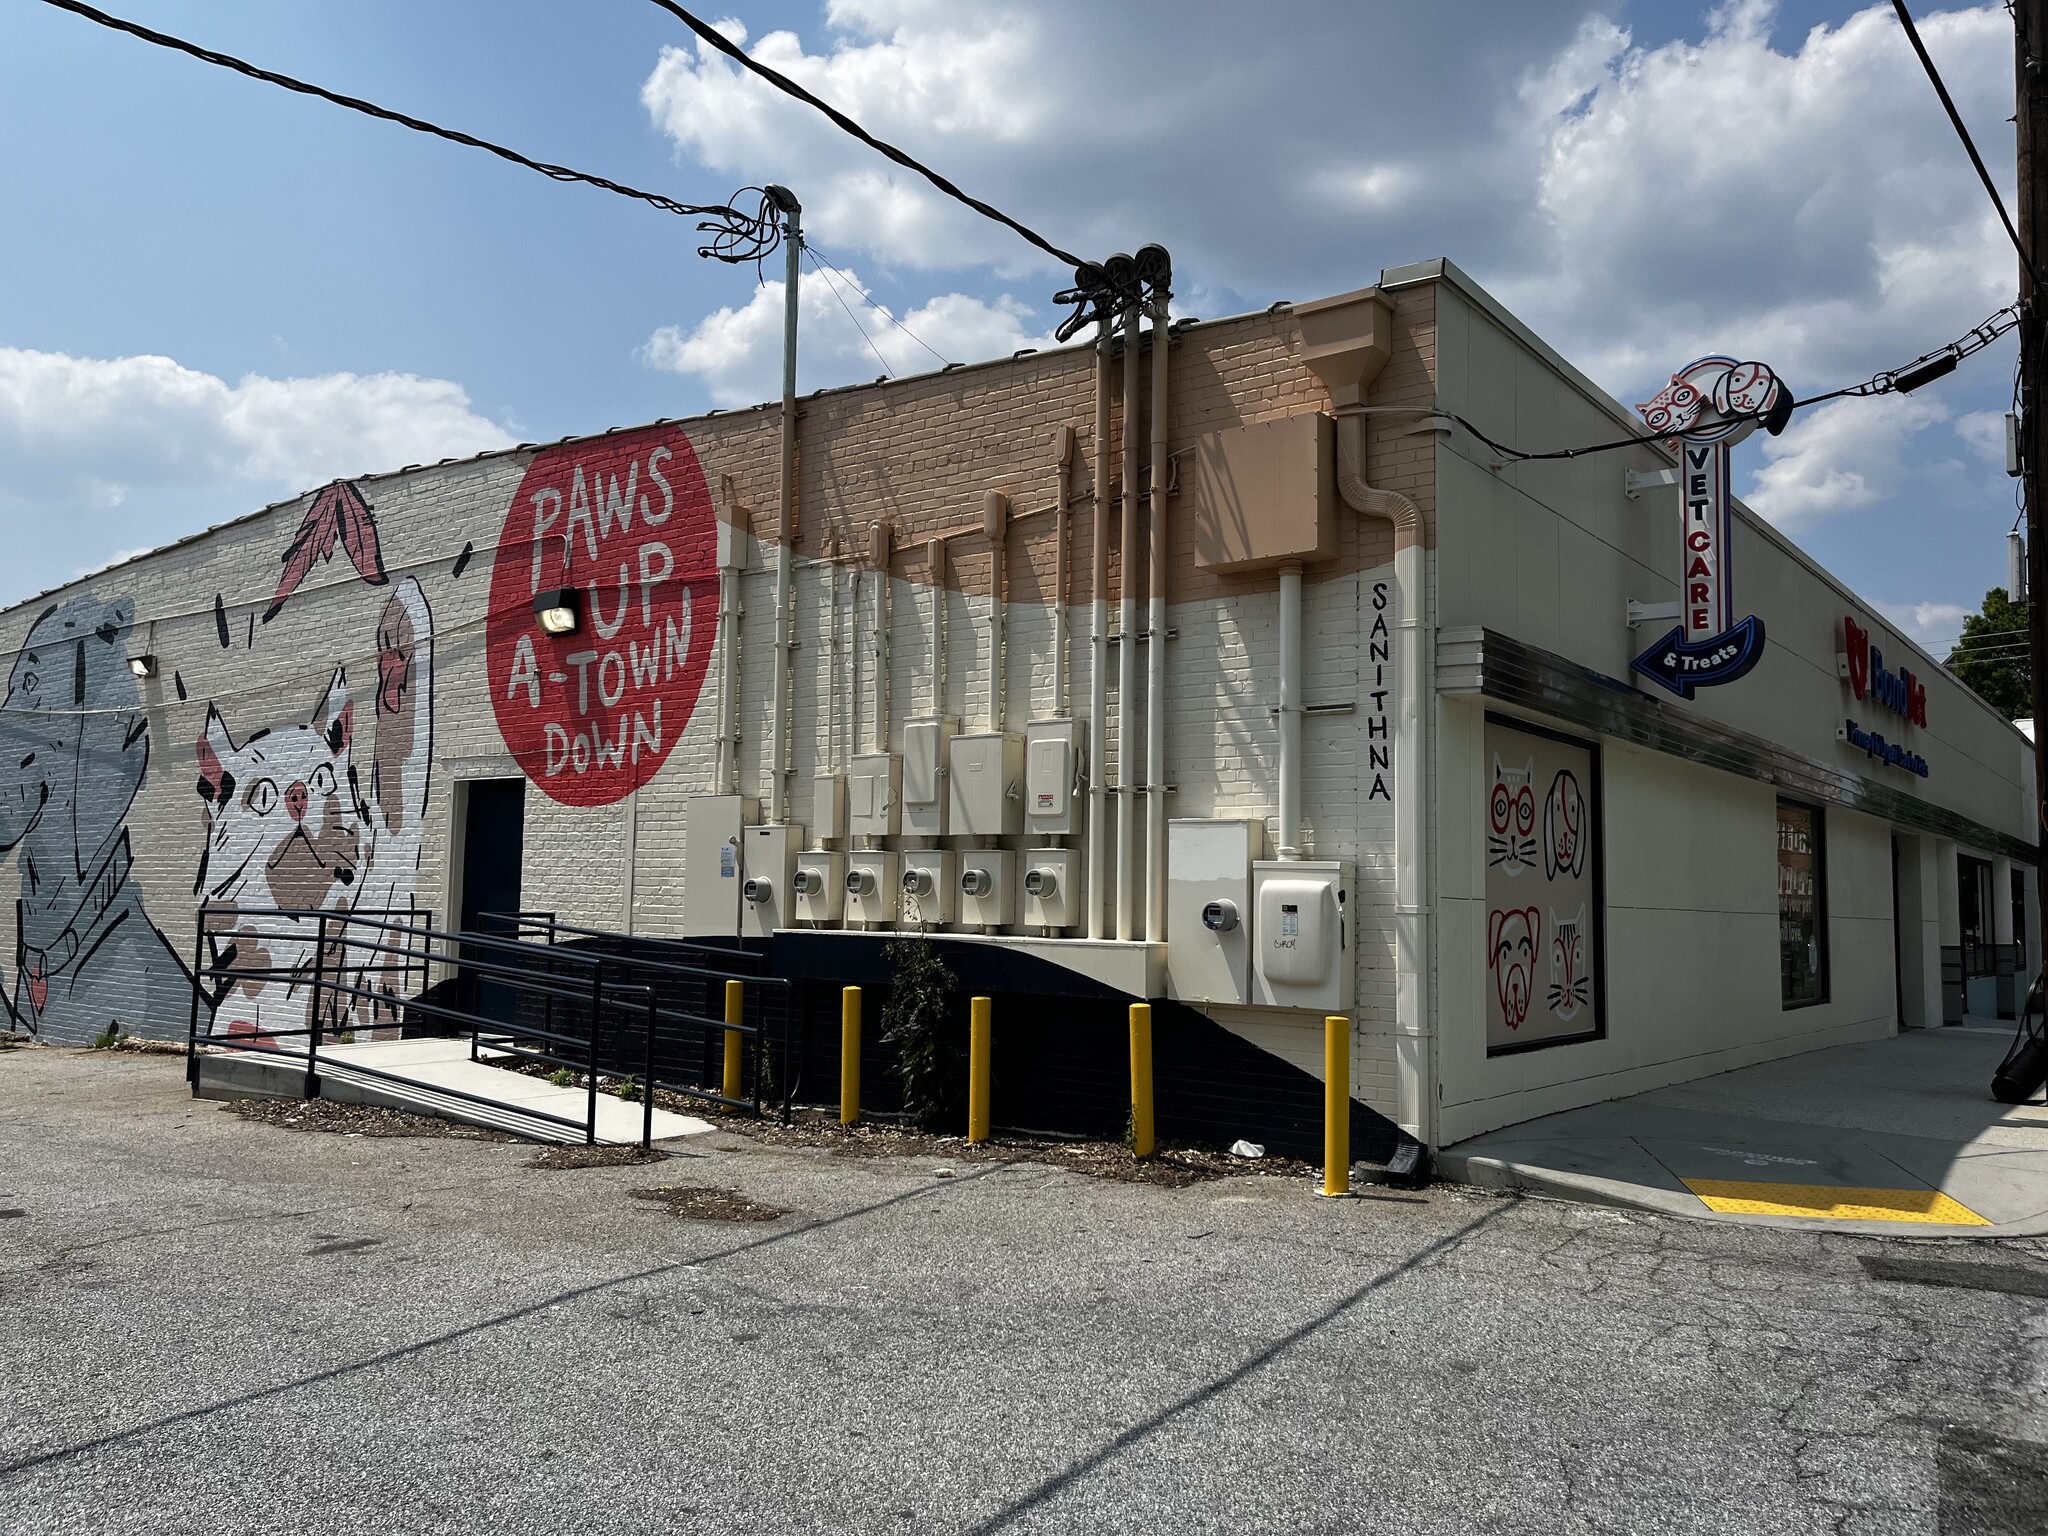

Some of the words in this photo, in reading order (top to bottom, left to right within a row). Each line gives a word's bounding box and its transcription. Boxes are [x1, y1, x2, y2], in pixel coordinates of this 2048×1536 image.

[530, 446, 673, 594] PAWS
[1687, 447, 1711, 521] VET
[589, 541, 675, 640] UP
[1687, 531, 1711, 631] CARE
[507, 586, 692, 715] A-TOWN
[1663, 652, 1677, 668] &
[1681, 644, 1738, 670] Treats
[543, 698, 662, 777] DOWN
